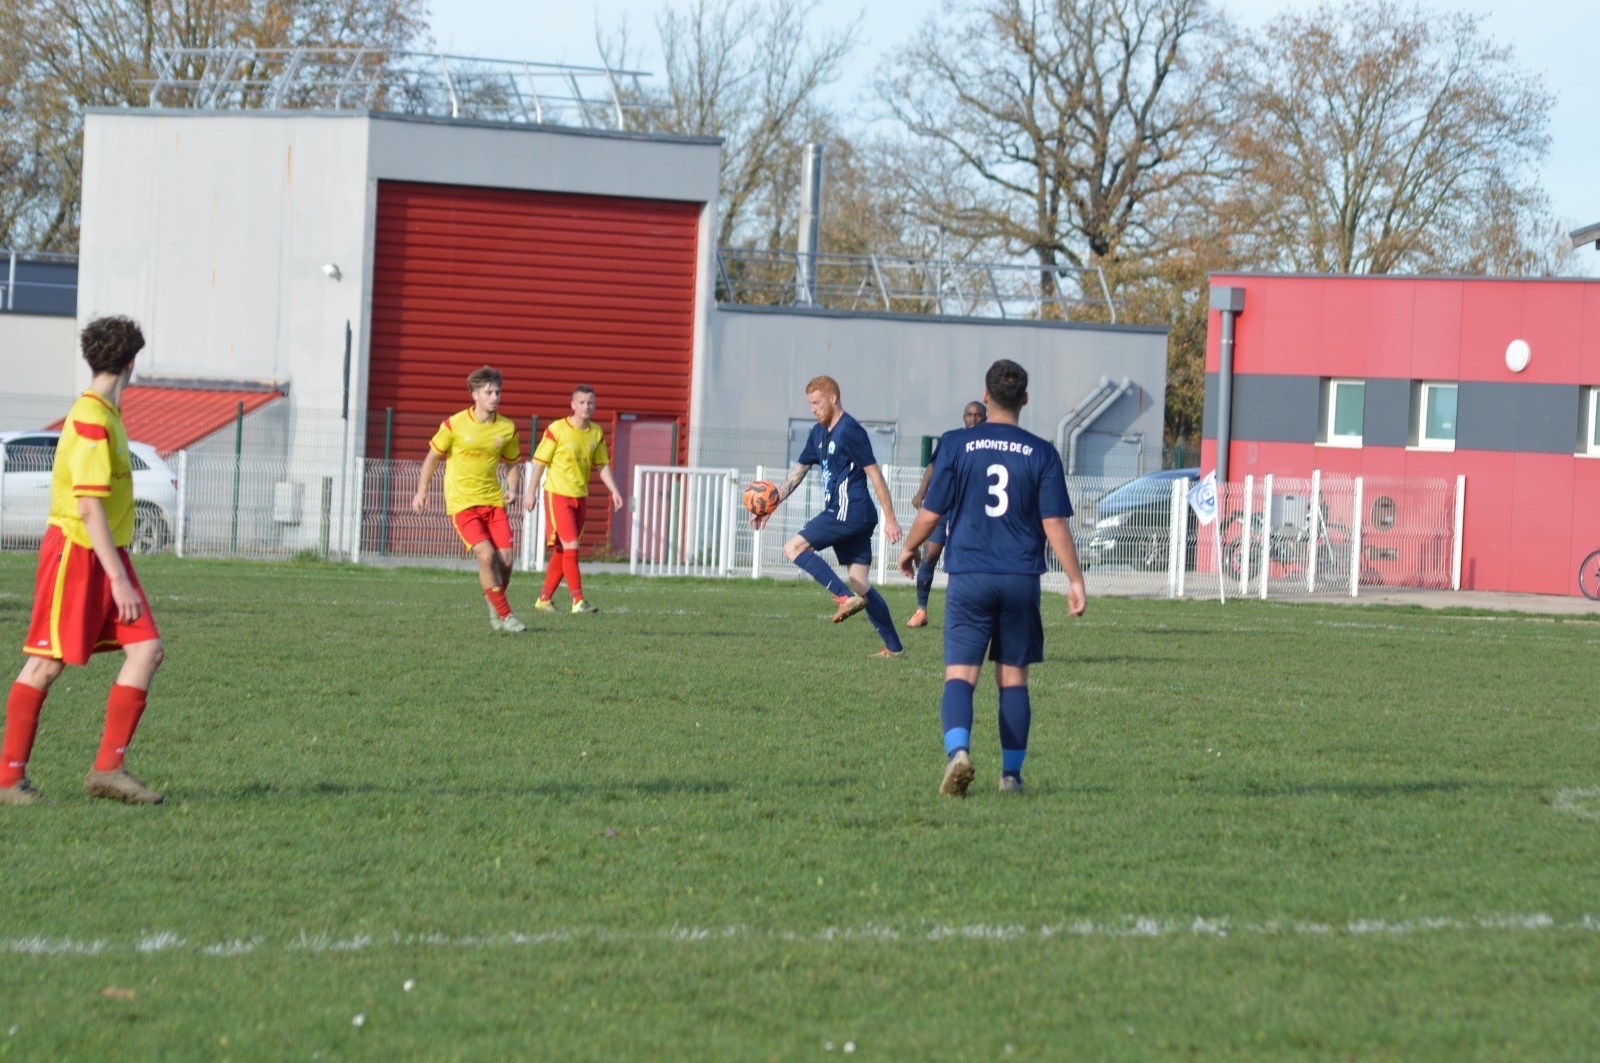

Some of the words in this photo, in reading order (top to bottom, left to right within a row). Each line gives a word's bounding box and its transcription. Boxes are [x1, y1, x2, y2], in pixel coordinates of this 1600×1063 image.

[966, 441, 975, 453] FC
[975, 439, 1008, 452] MONTS
[1009, 442, 1022, 454] DE
[985, 464, 1008, 517] 3
